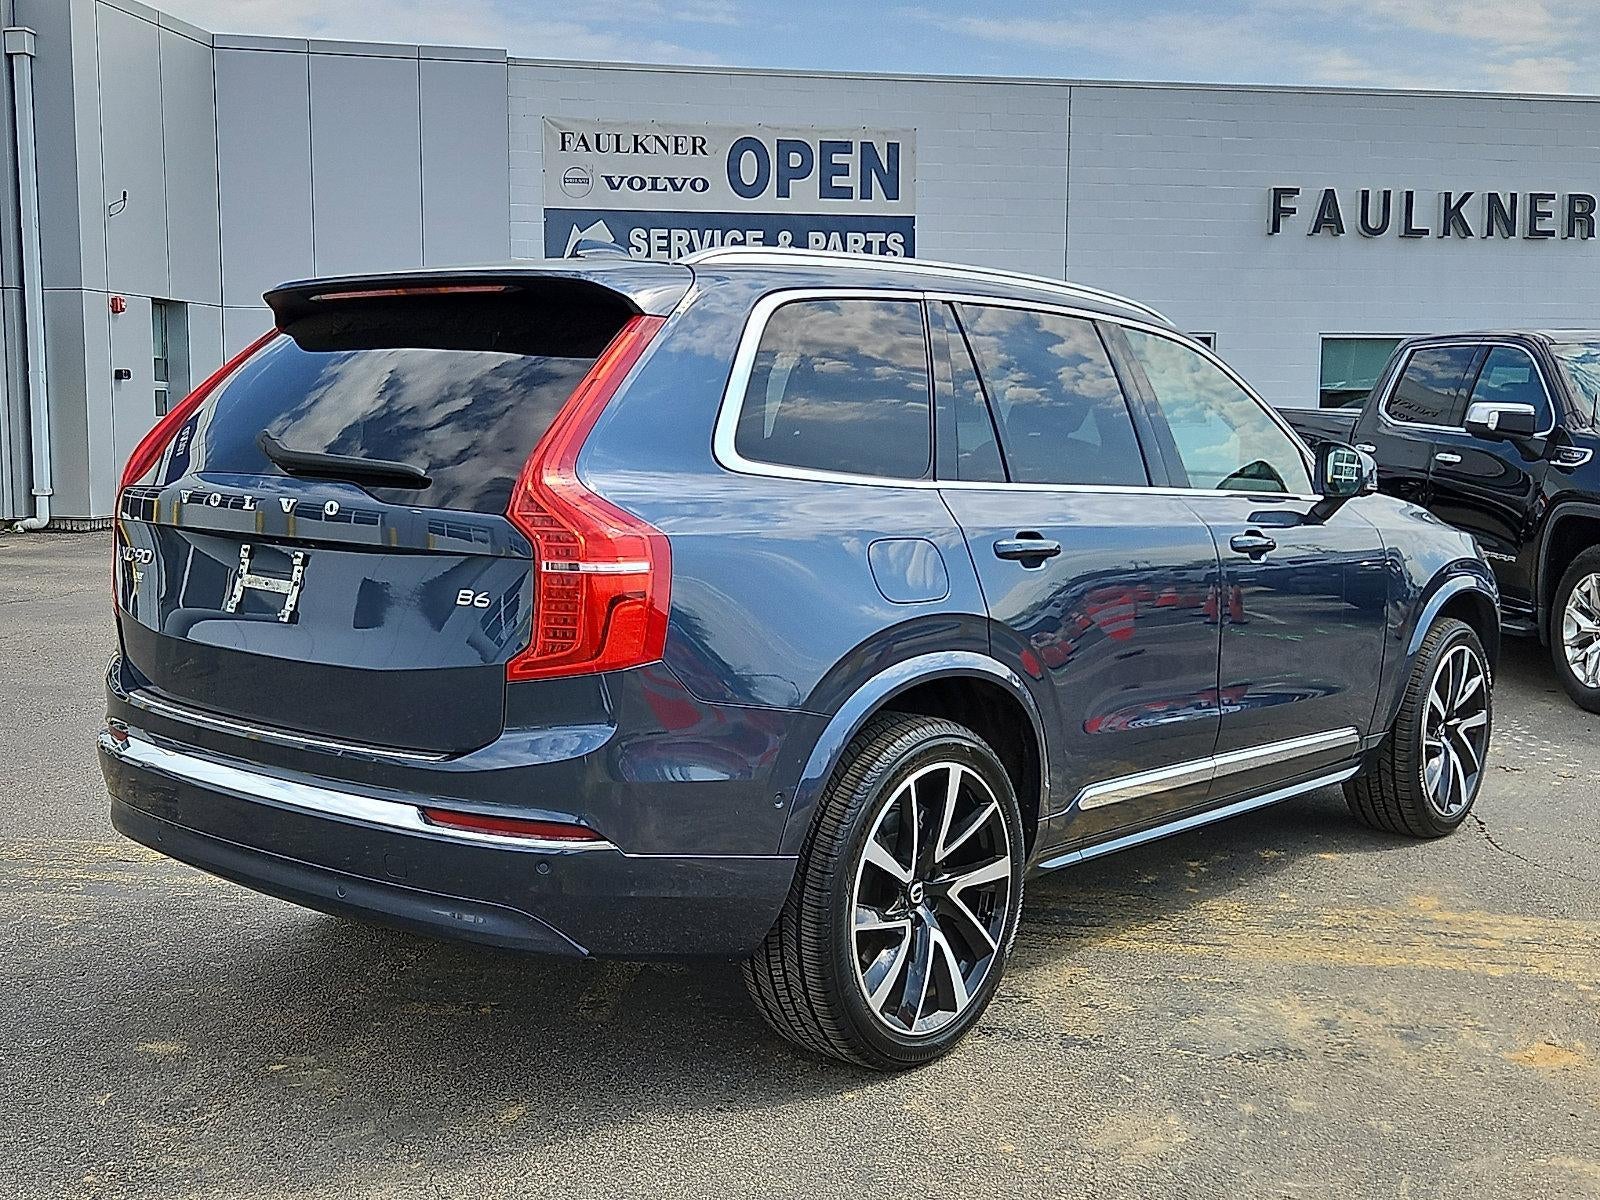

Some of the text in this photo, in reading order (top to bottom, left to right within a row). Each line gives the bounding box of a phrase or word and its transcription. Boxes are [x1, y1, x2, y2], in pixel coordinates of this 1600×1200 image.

[558, 131, 710, 157] FAULKNER
[726, 136, 900, 201] OPEN
[601, 175, 710, 193] VOLVO
[1267, 187, 1598, 240] FAULKNER
[808, 231, 906, 257] PARTS
[180, 489, 340, 516] VOLVO
[456, 589, 491, 608] B6
